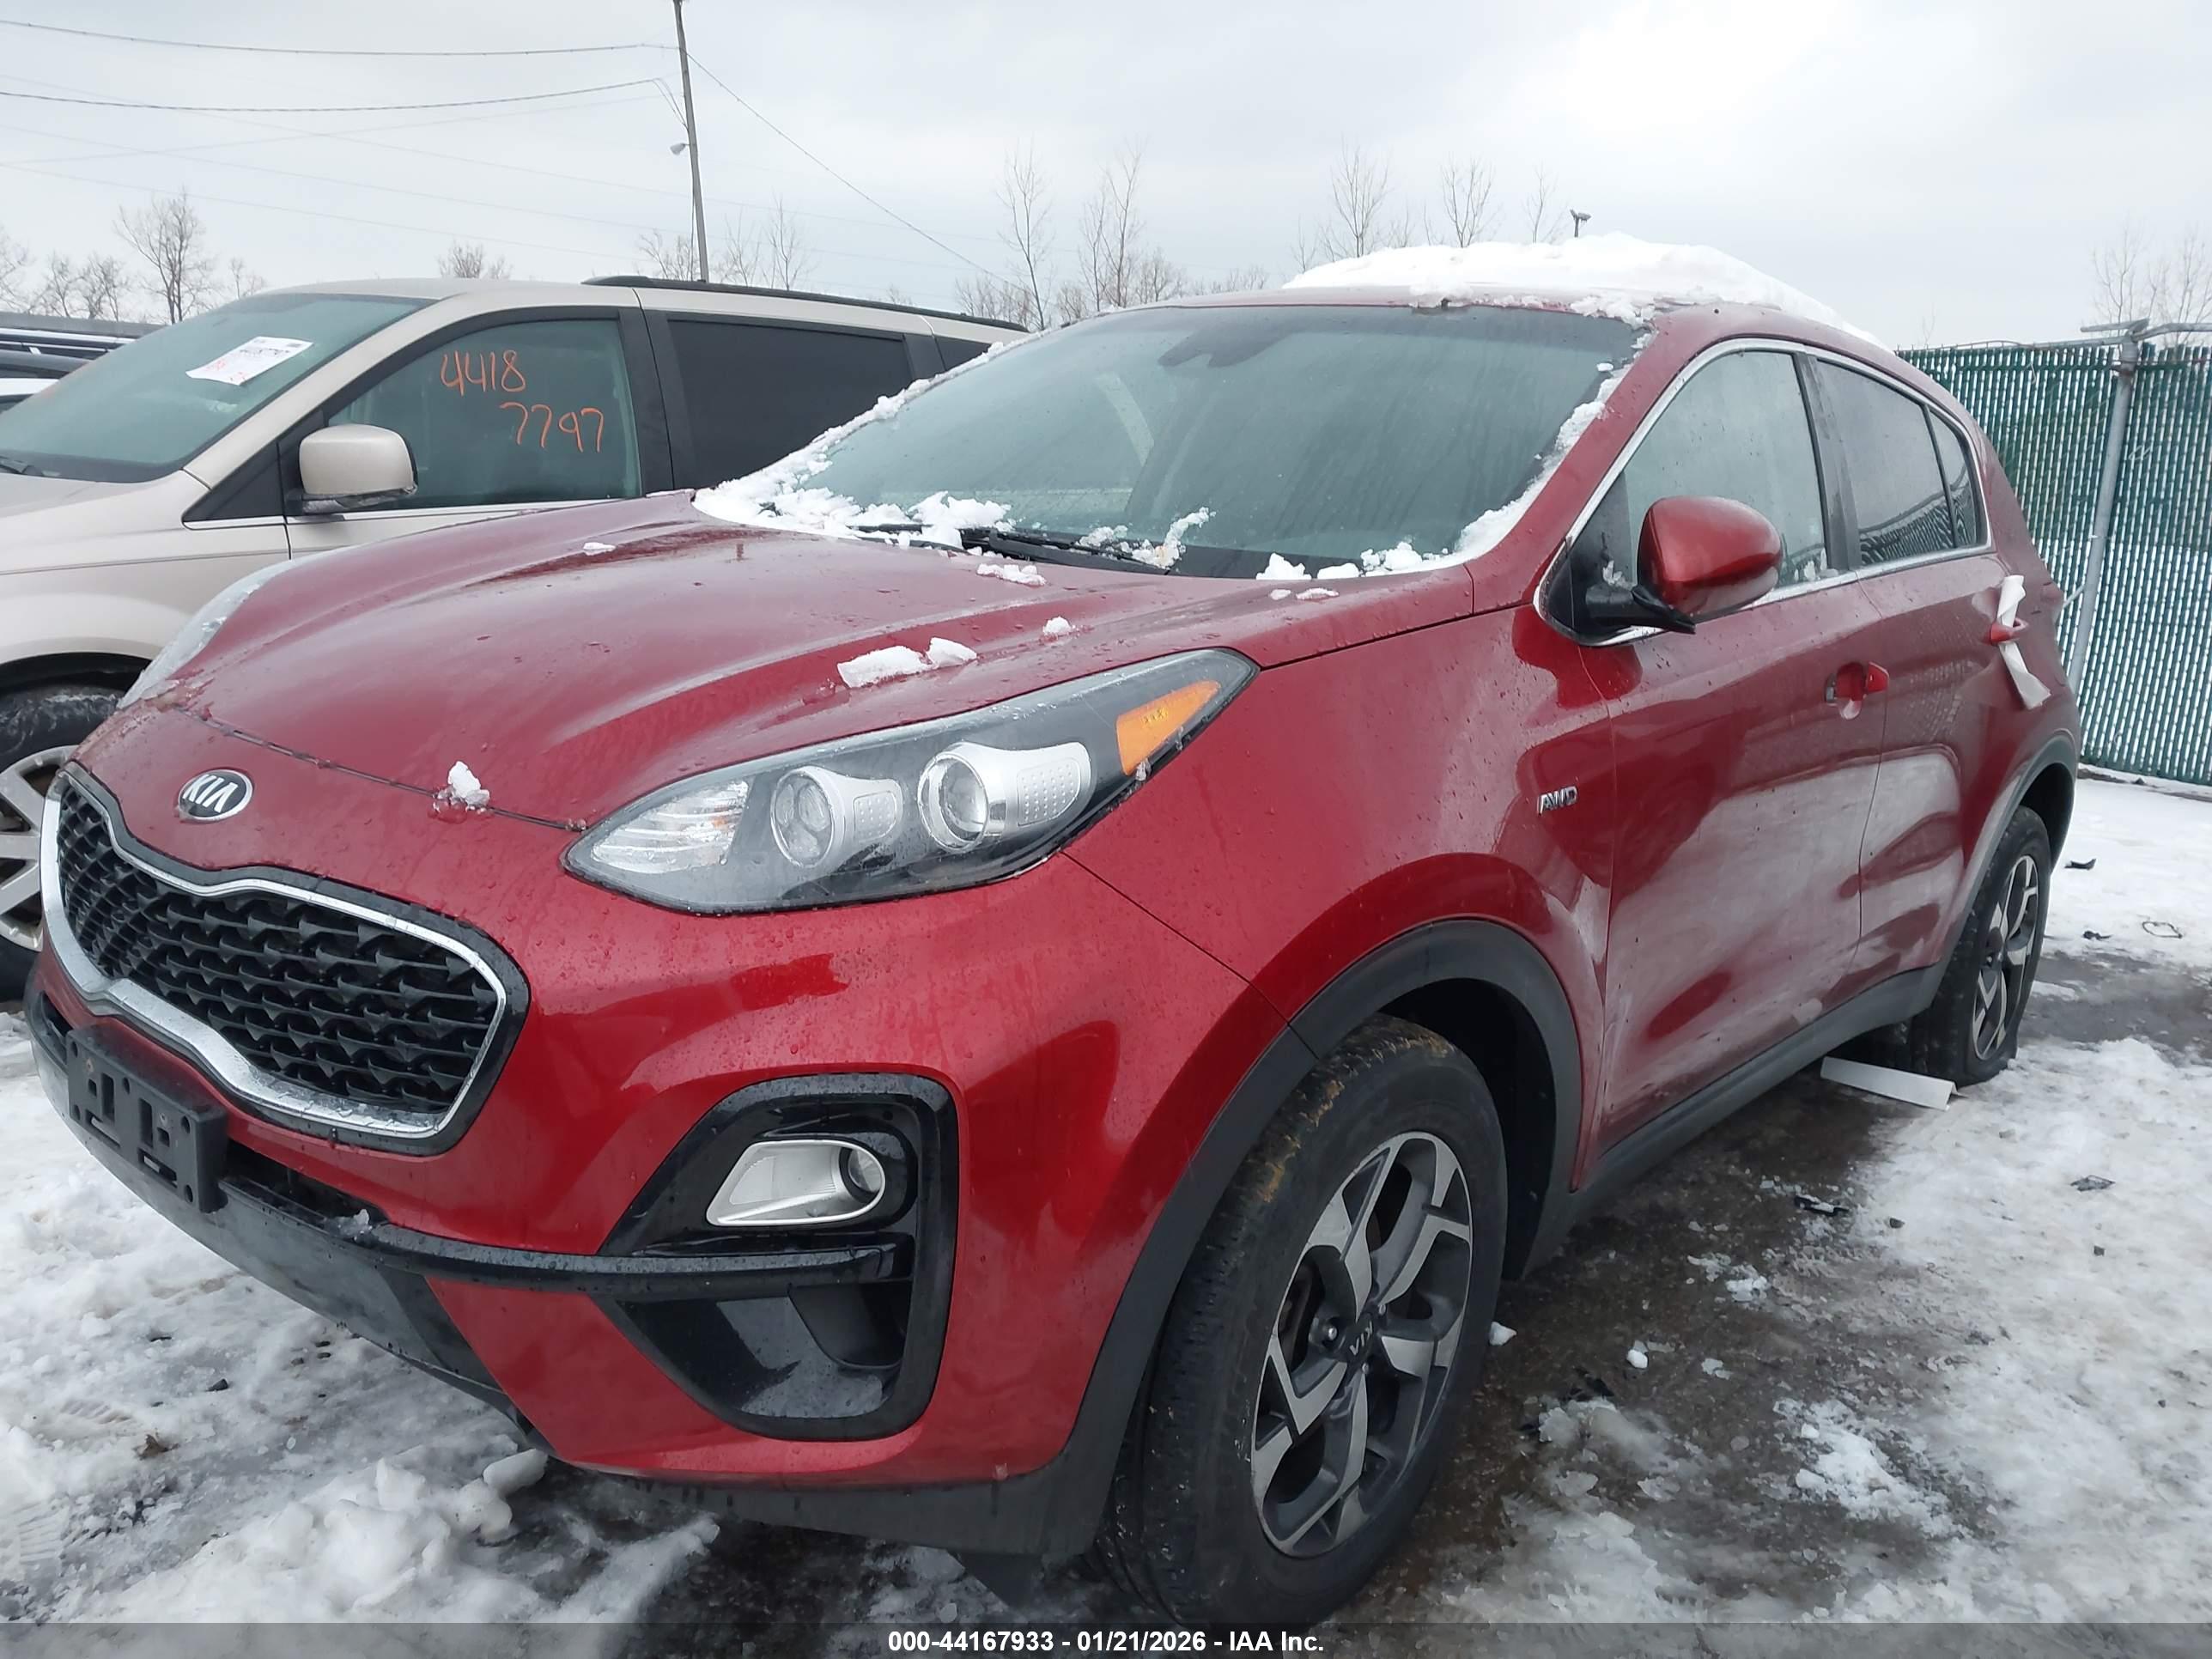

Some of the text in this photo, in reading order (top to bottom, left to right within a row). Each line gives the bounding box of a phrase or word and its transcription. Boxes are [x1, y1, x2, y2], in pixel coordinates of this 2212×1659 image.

[440, 349, 526, 397] 4418
[499, 401, 605, 453] 7797
[182, 774, 239, 813] KIA
[1539, 786, 1577, 814] AWD
